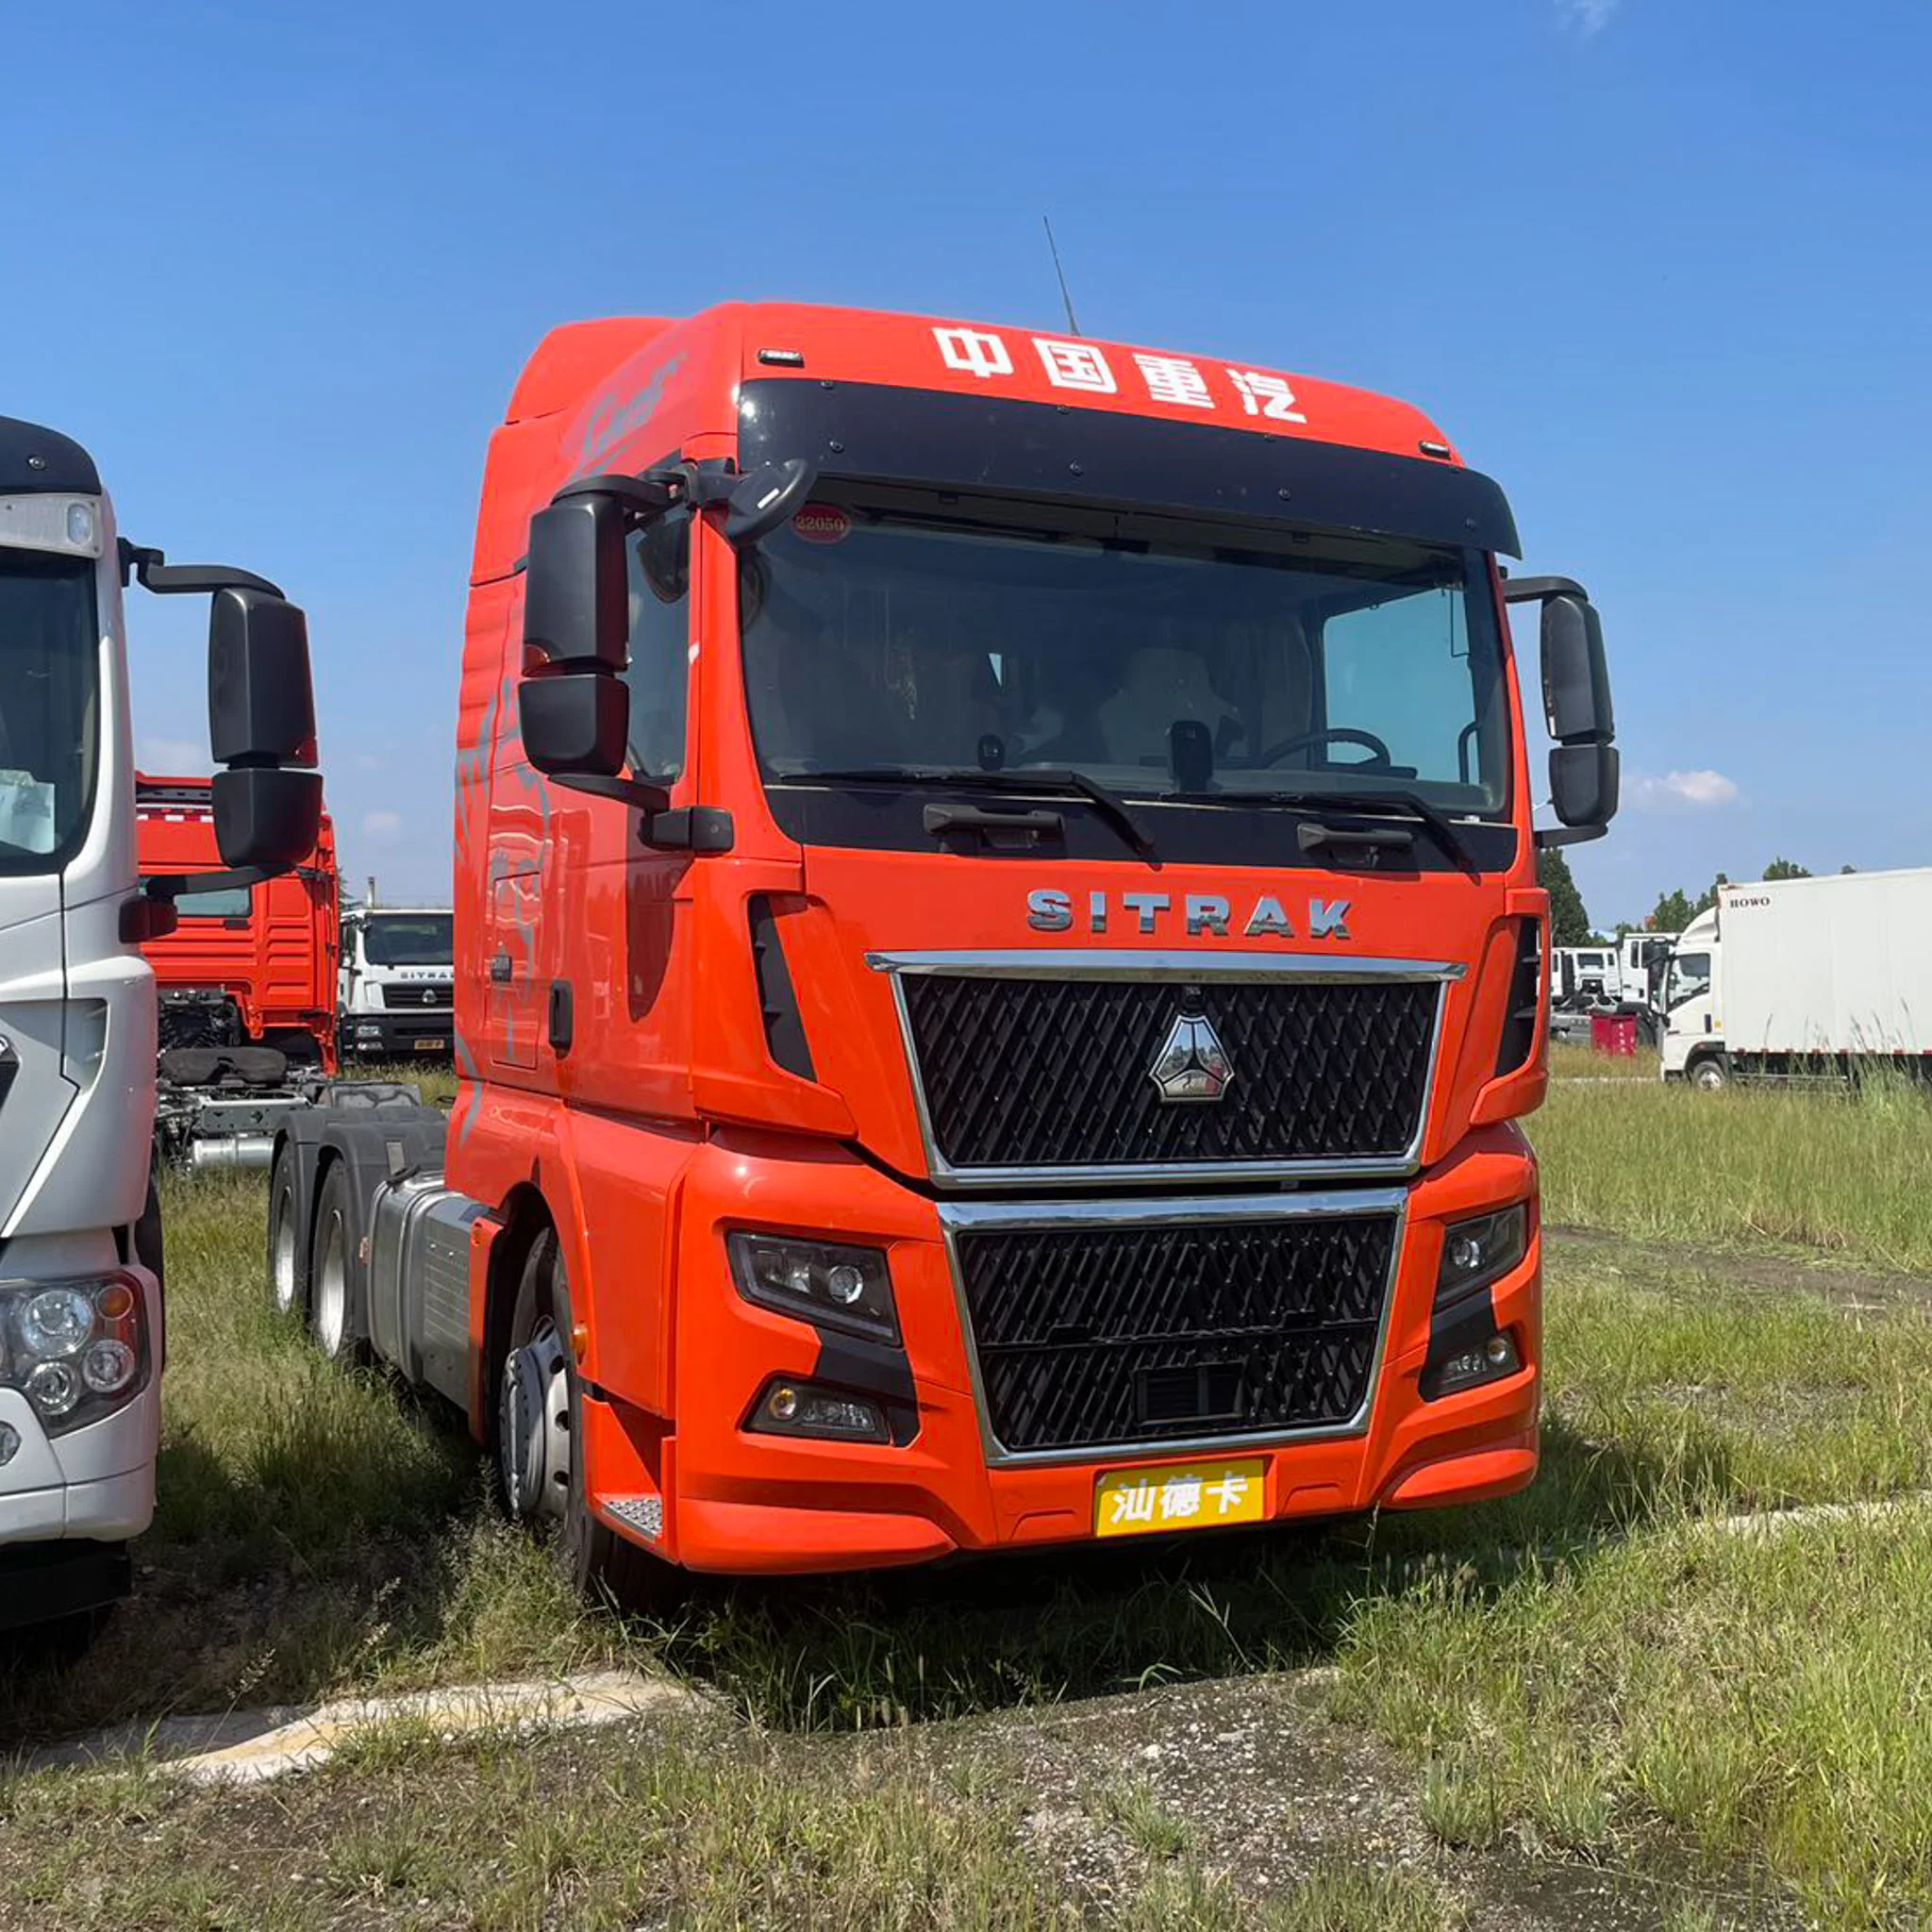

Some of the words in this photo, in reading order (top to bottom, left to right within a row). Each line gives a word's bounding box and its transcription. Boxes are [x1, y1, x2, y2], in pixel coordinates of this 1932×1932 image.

[931, 326, 1307, 424] 中国重汽
[1026, 889, 1352, 940] SITRAK
[1729, 896, 1771, 908] HOWO
[1110, 1470, 1248, 1524] 汕德卡
